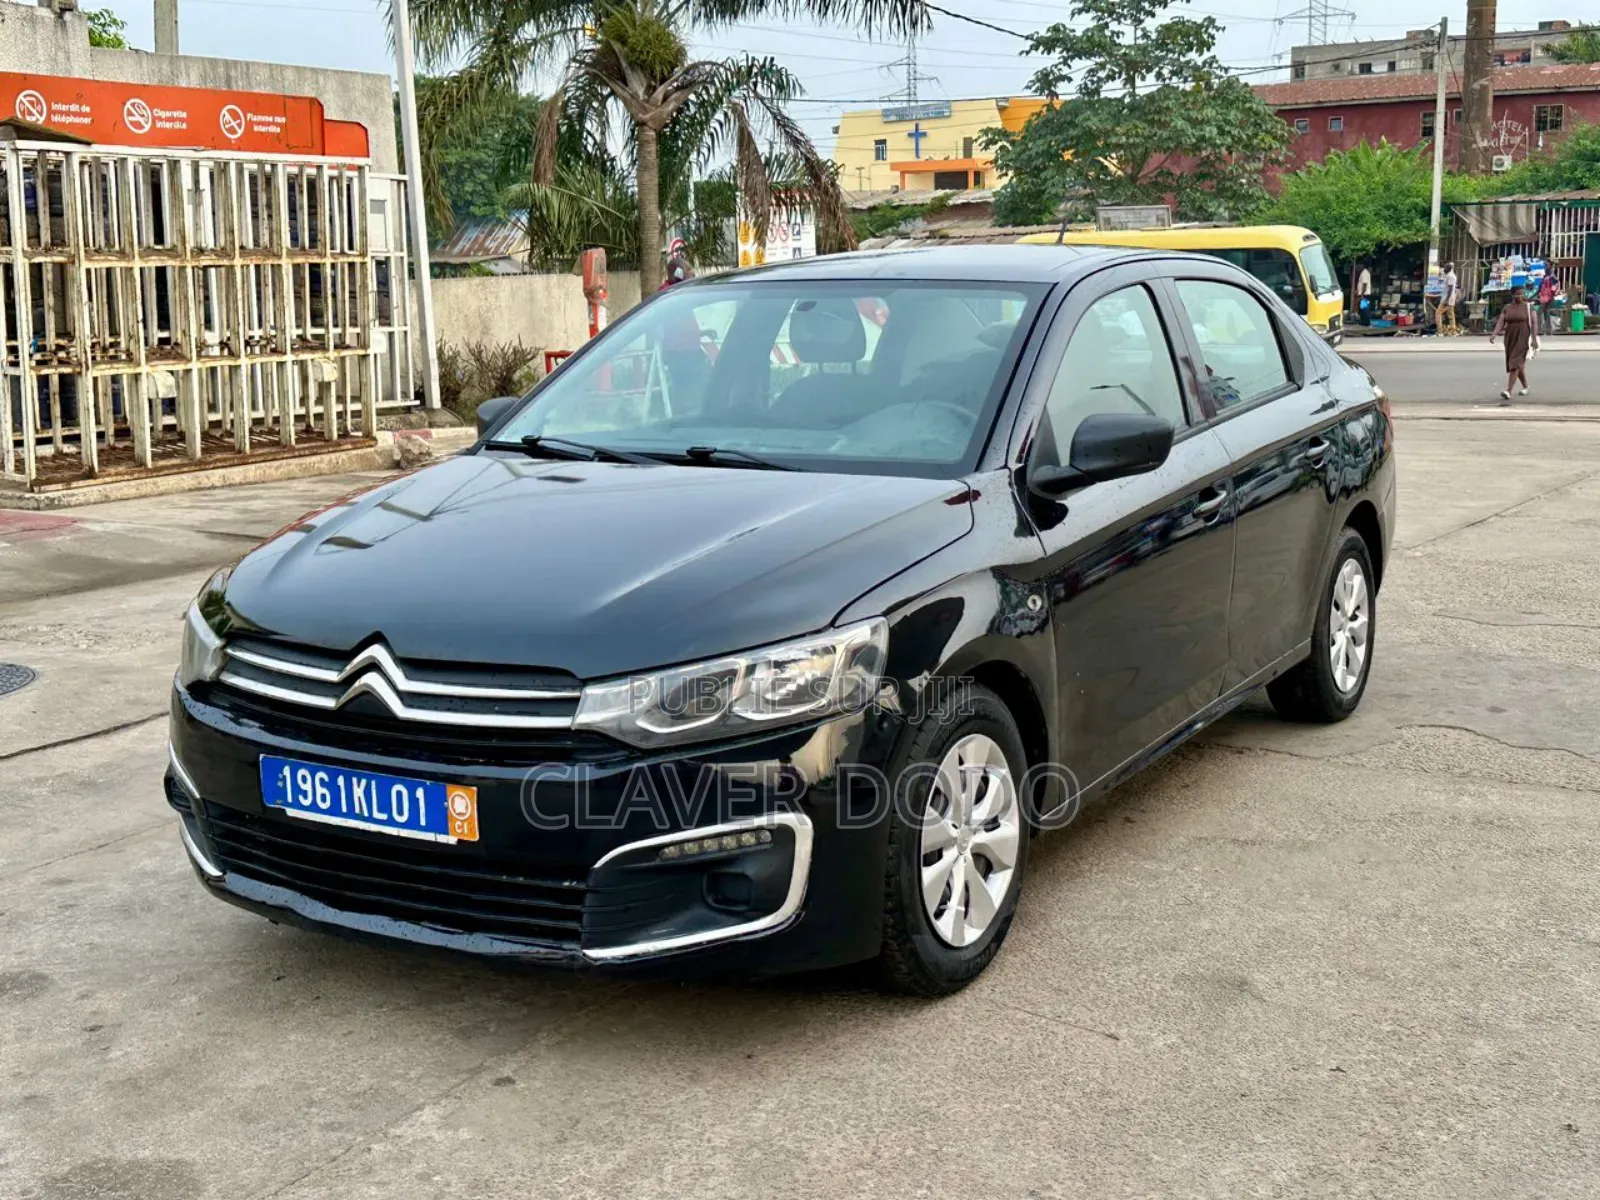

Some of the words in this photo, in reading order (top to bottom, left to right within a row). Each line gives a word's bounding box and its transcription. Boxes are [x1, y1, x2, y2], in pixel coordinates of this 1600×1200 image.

[51, 101, 80, 112] Interdit
[80, 104, 91, 113] de
[153, 108, 187, 119] Cigarette
[247, 113, 273, 123] Flamme
[274, 116, 286, 124] nue
[454, 820, 469, 835] CI
